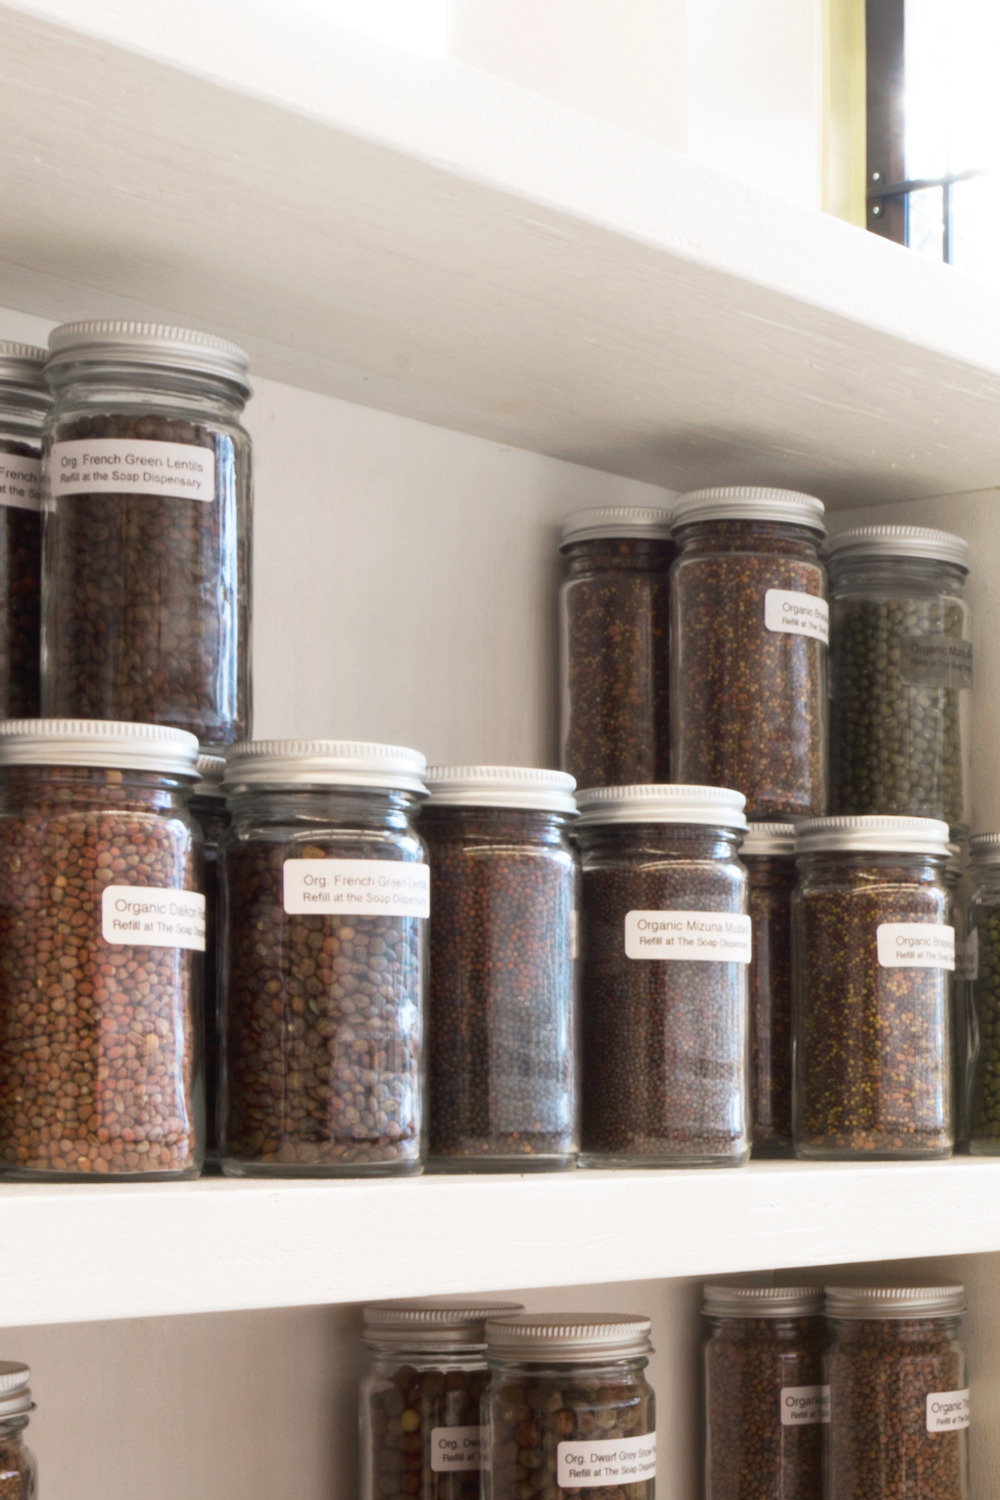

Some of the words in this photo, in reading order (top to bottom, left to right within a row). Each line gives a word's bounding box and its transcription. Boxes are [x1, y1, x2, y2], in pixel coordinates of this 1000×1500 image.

[83, 454, 122, 466] French
[125, 454, 163, 467] Green
[167, 457, 205, 473] Lentils
[60, 472, 80, 484] Refill
[112, 471, 141, 483] Soap
[143, 472, 202, 490] Dispensary
[782, 601, 814, 616] Organic
[334, 875, 374, 887] French
[378, 876, 406, 889] Green
[303, 892, 330, 902] Refill
[334, 893, 343, 902] at
[346, 892, 363, 902] the
[366, 893, 391, 904] Soap
[115, 898, 166, 916] Organic
[112, 919, 140, 930] Refill
[143, 922, 153, 931] at
[157, 921, 173, 933] The
[638, 919, 683, 933] Organic
[687, 921, 723, 932] Mizuna
[640, 936, 662, 945] Refill
[677, 937, 694, 946] The
[697, 938, 718, 947] Soap
[896, 935, 931, 947] Organic
[931, 1402, 962, 1415] Organic
[590, 1452, 617, 1463] Dwarf
[619, 1450, 637, 1461] Grey
[569, 1468, 591, 1477] Refill
[604, 1467, 619, 1475] The
